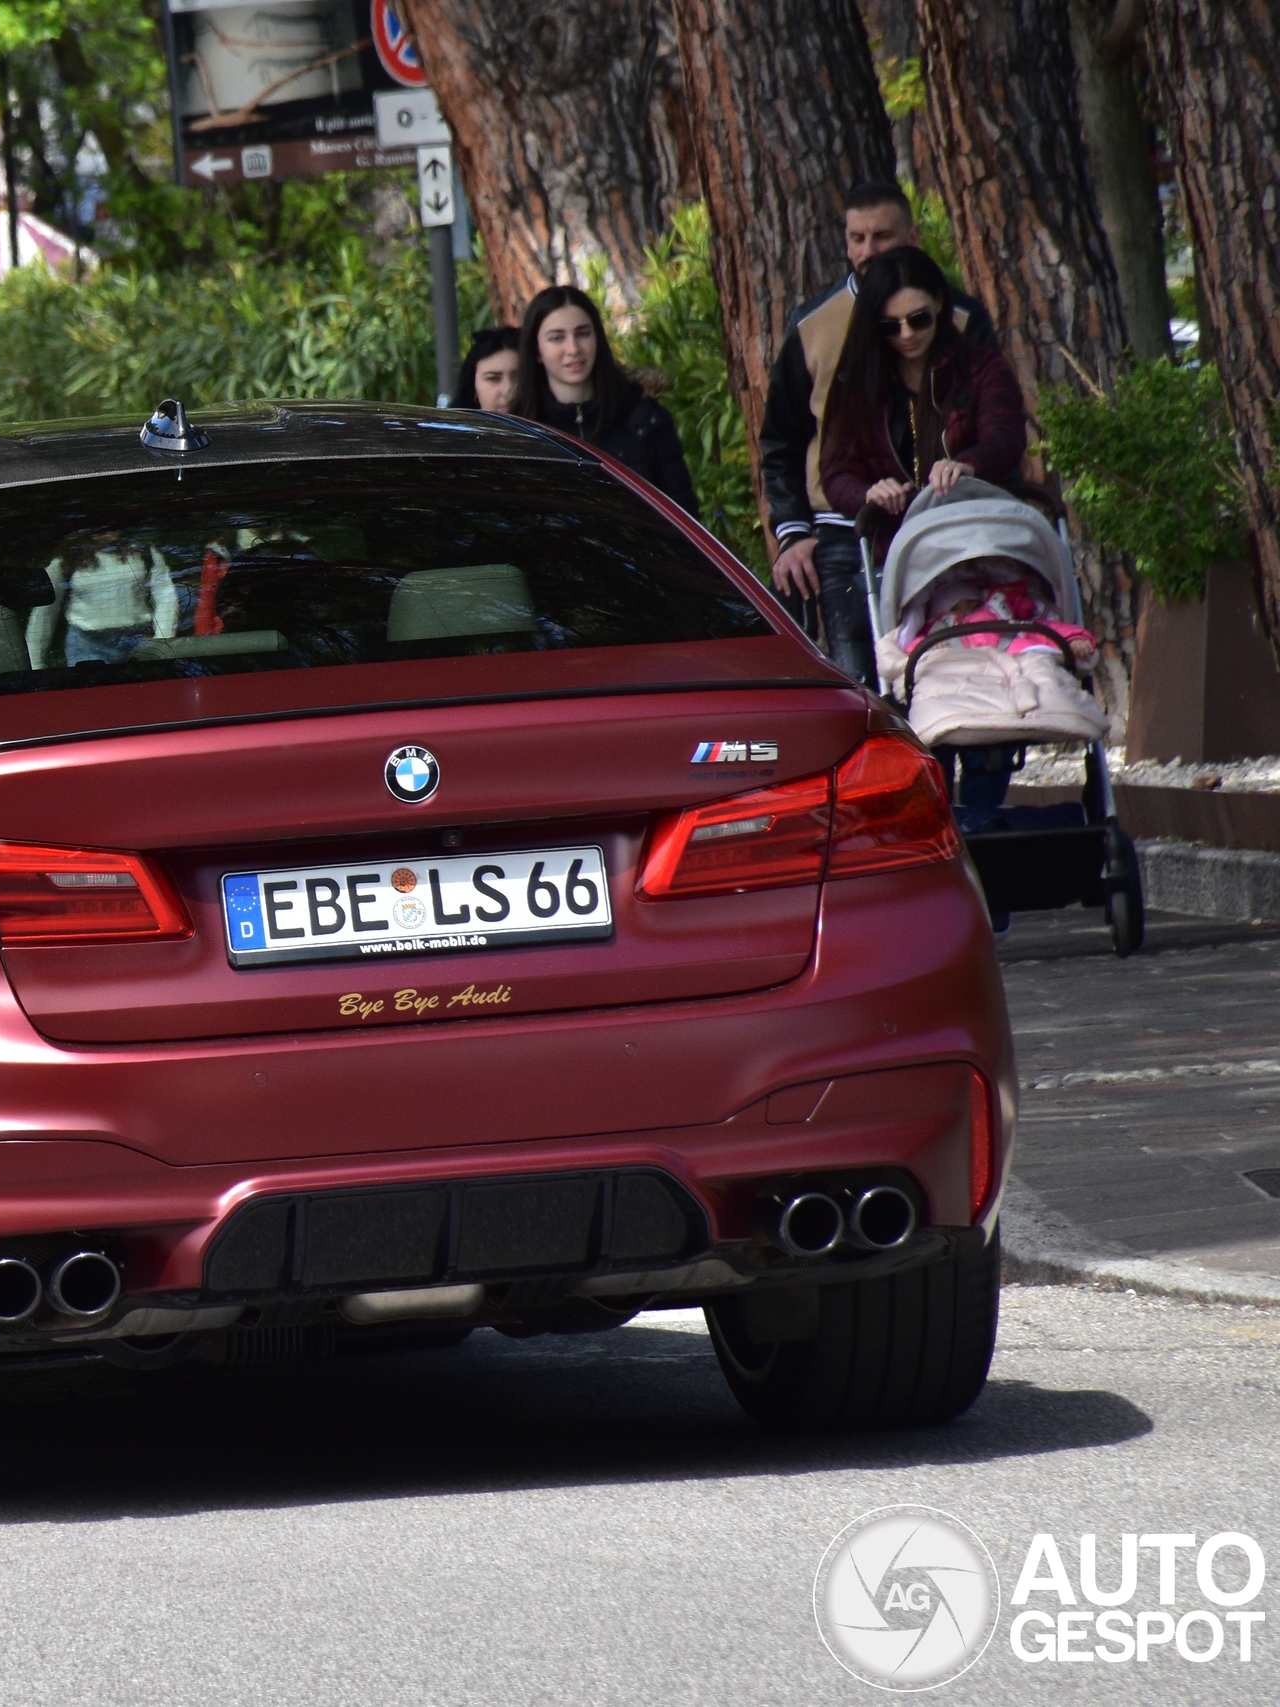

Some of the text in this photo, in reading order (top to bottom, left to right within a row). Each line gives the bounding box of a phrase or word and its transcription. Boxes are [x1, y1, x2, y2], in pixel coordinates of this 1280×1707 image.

[397, 109, 413, 129] 0
[389, 748, 434, 767] BMW
[715, 740, 778, 762] M5
[264, 873, 389, 940] EBE
[428, 864, 511, 926] LS
[526, 858, 599, 918] 66
[240, 921, 254, 939] D
[338, 984, 512, 1020] Bye Bye Audi
